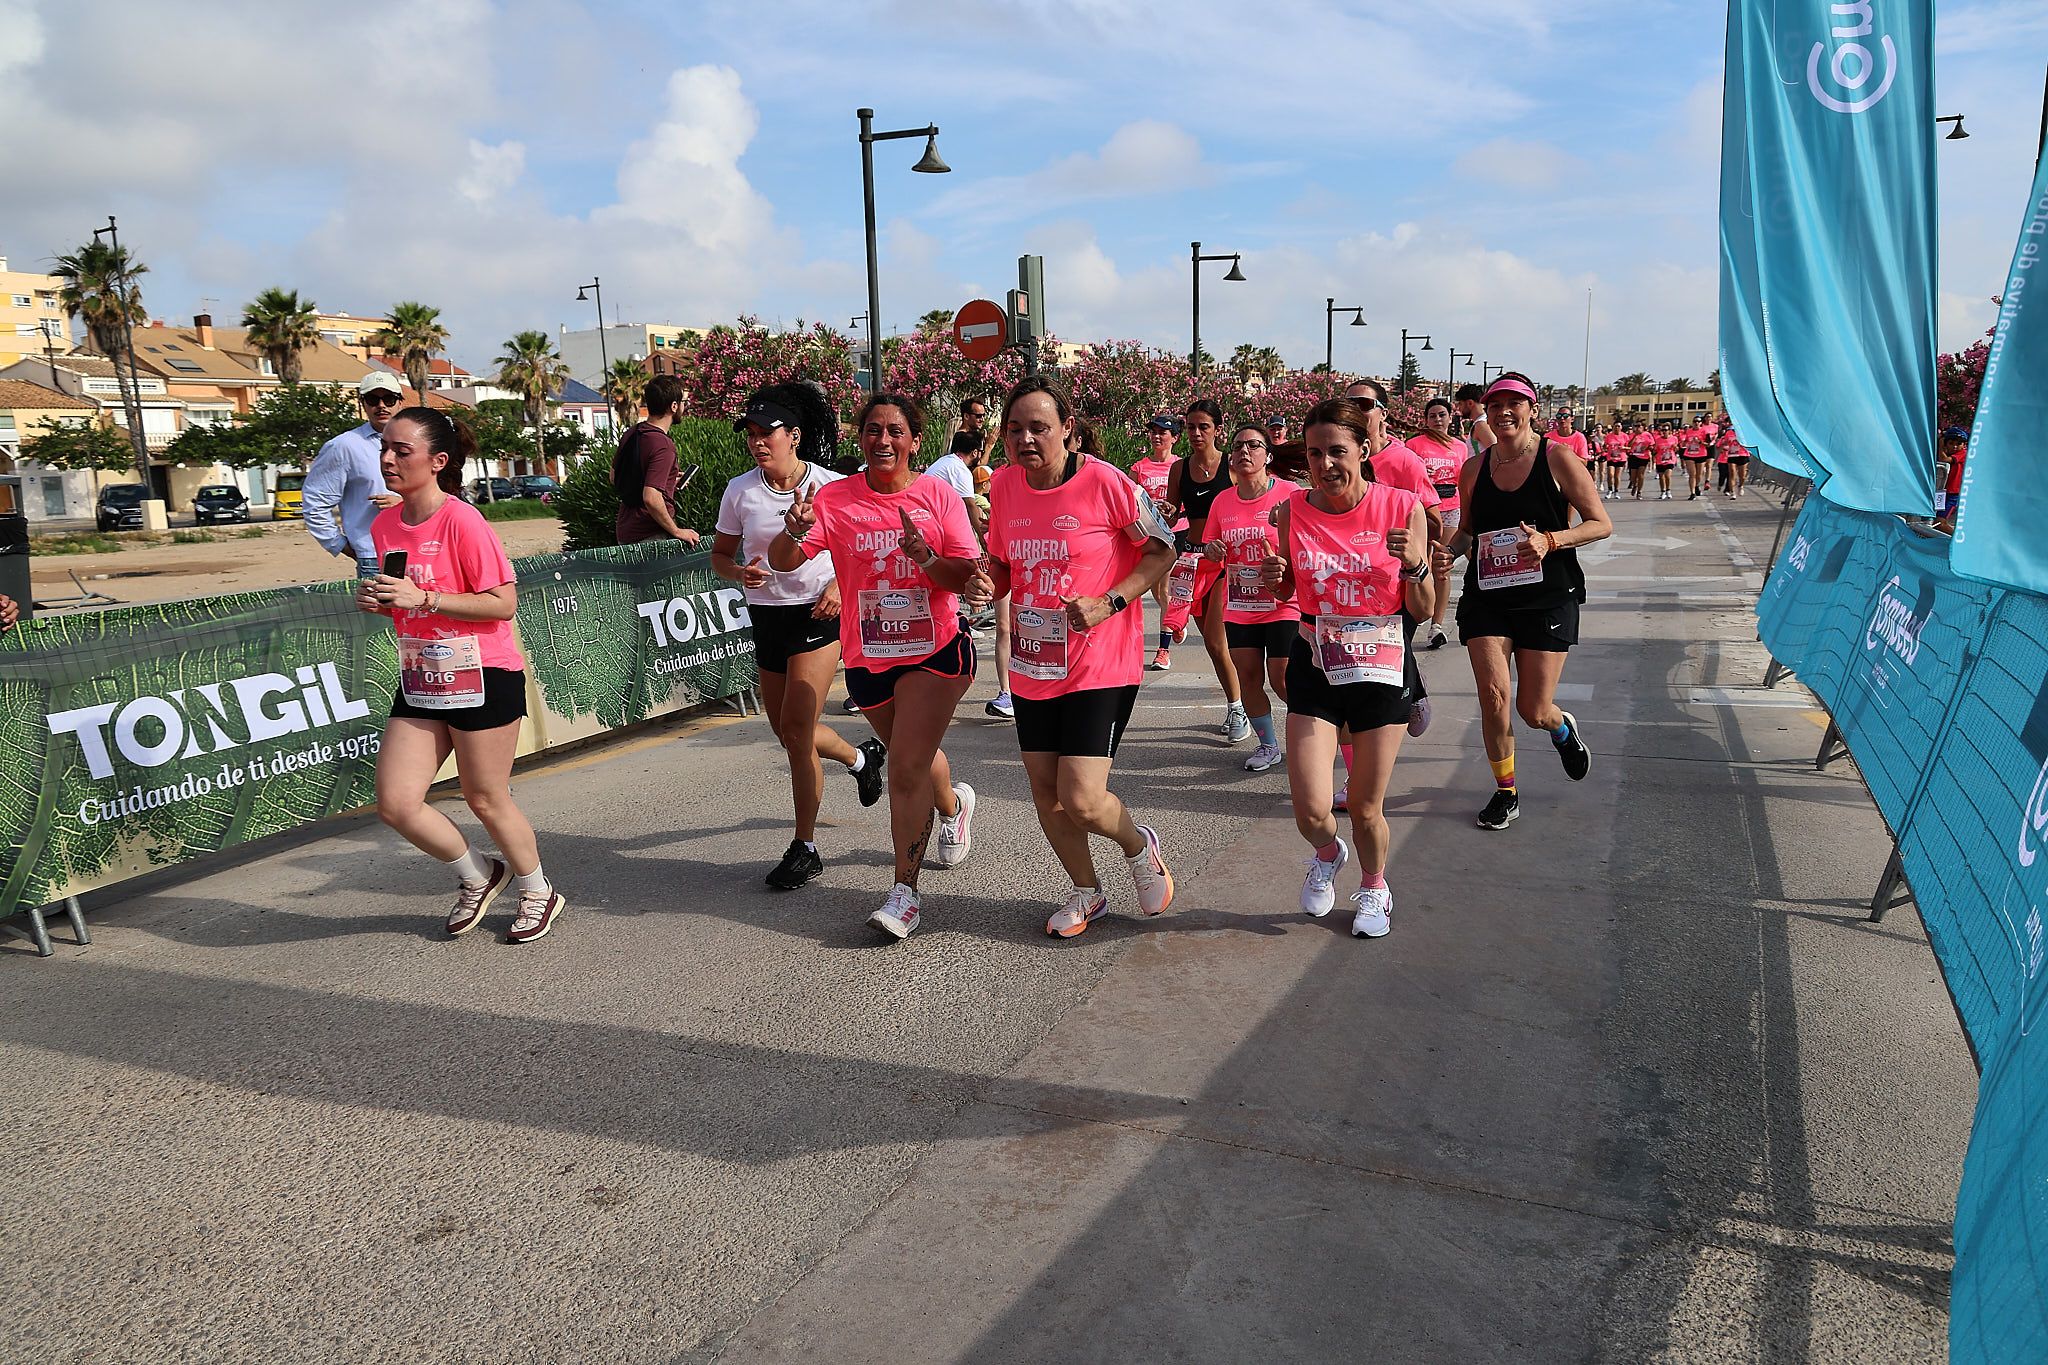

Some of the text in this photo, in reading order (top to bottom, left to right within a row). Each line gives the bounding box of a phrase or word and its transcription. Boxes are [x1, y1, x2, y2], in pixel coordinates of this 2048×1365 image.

[1009, 519, 1032, 528] OYSHO
[1494, 555, 1518, 567] 016
[1242, 587, 1259, 595] 016
[552, 596, 578, 615] 1975
[882, 621, 910, 632] 016
[1020, 638, 1040, 652] 016
[1345, 644, 1377, 655] 016
[654, 639, 755, 675] Cuidando de ti des
[425, 671, 456, 683] 016
[1332, 672, 1354, 680] OYSHO
[80, 732, 381, 826] Cuidando de ti desde 1975
